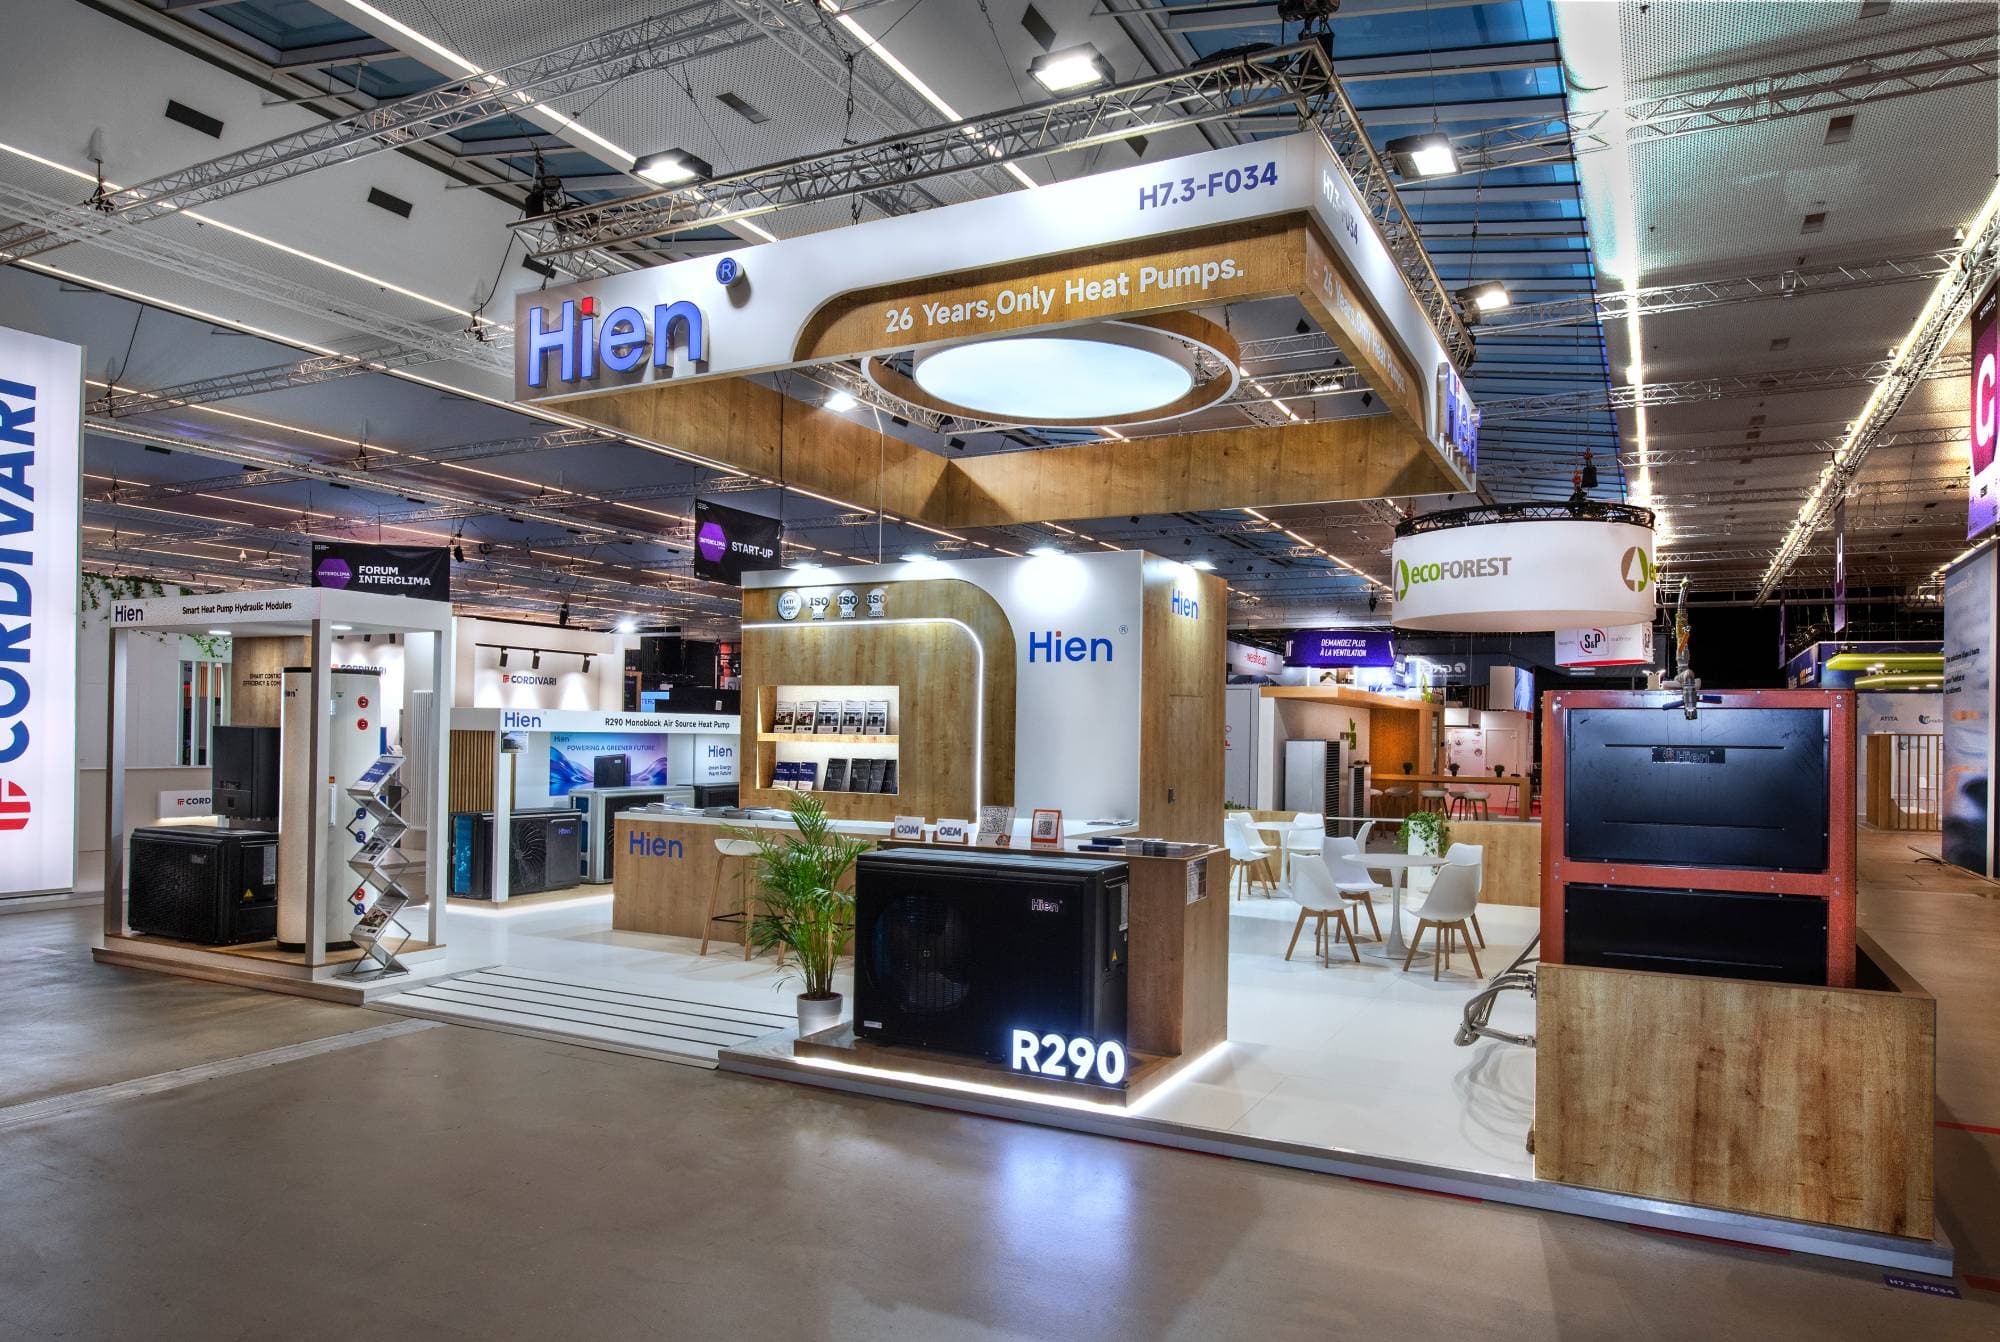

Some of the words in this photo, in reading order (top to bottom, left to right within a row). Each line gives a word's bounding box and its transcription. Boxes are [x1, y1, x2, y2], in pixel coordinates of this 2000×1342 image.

[1138, 161, 1278, 211] H7.3-F034
[1322, 168, 1359, 246] H7.3034
[885, 309, 914, 334] 26
[1065, 272, 1129, 305] Heat
[1139, 258, 1244, 293] Pumps.
[528, 296, 702, 388] Hien
[731, 541, 774, 559] START-UP
[358, 565, 399, 576] FORUM
[1410, 556, 1513, 585] ecoFOREST
[358, 576, 432, 586] INTERCLIMA
[810, 597, 829, 606] ISO
[838, 595, 858, 605] ISO
[867, 594, 888, 604] ISO
[1171, 588, 1199, 621] Hien
[114, 605, 144, 622] Hien
[182, 606, 200, 615] Smart
[201, 604, 216, 614] Heat
[216, 604, 234, 615] Pump
[234, 601, 264, 614] Hydraulic
[265, 601, 292, 611] Modules
[1029, 630, 1113, 663] Hien
[1320, 638, 1352, 647] DEMANDEZ
[1352, 639, 1367, 647] PLUS
[1584, 633, 1601, 649] S&P
[1325, 648, 1332, 656] LA
[1332, 648, 1367, 657] VENTILATION
[511, 675, 557, 686] CORDIVARI
[504, 711, 542, 728] Hien
[605, 717, 624, 727] R290
[625, 718, 662, 728] Monoblock
[664, 719, 674, 727] Air
[675, 720, 697, 728] Source
[698, 720, 713, 728] Heat
[713, 720, 730, 730] Pump
[554, 735, 570, 743] Hien
[708, 745, 733, 758] Hien
[1676, 750, 1710, 763] Hien
[897, 824, 919, 835] ODM
[939, 826, 962, 837] OEM
[629, 830, 683, 859] Hien
[1031, 898, 1059, 912] Hien
[1012, 1028, 1126, 1085] R290
